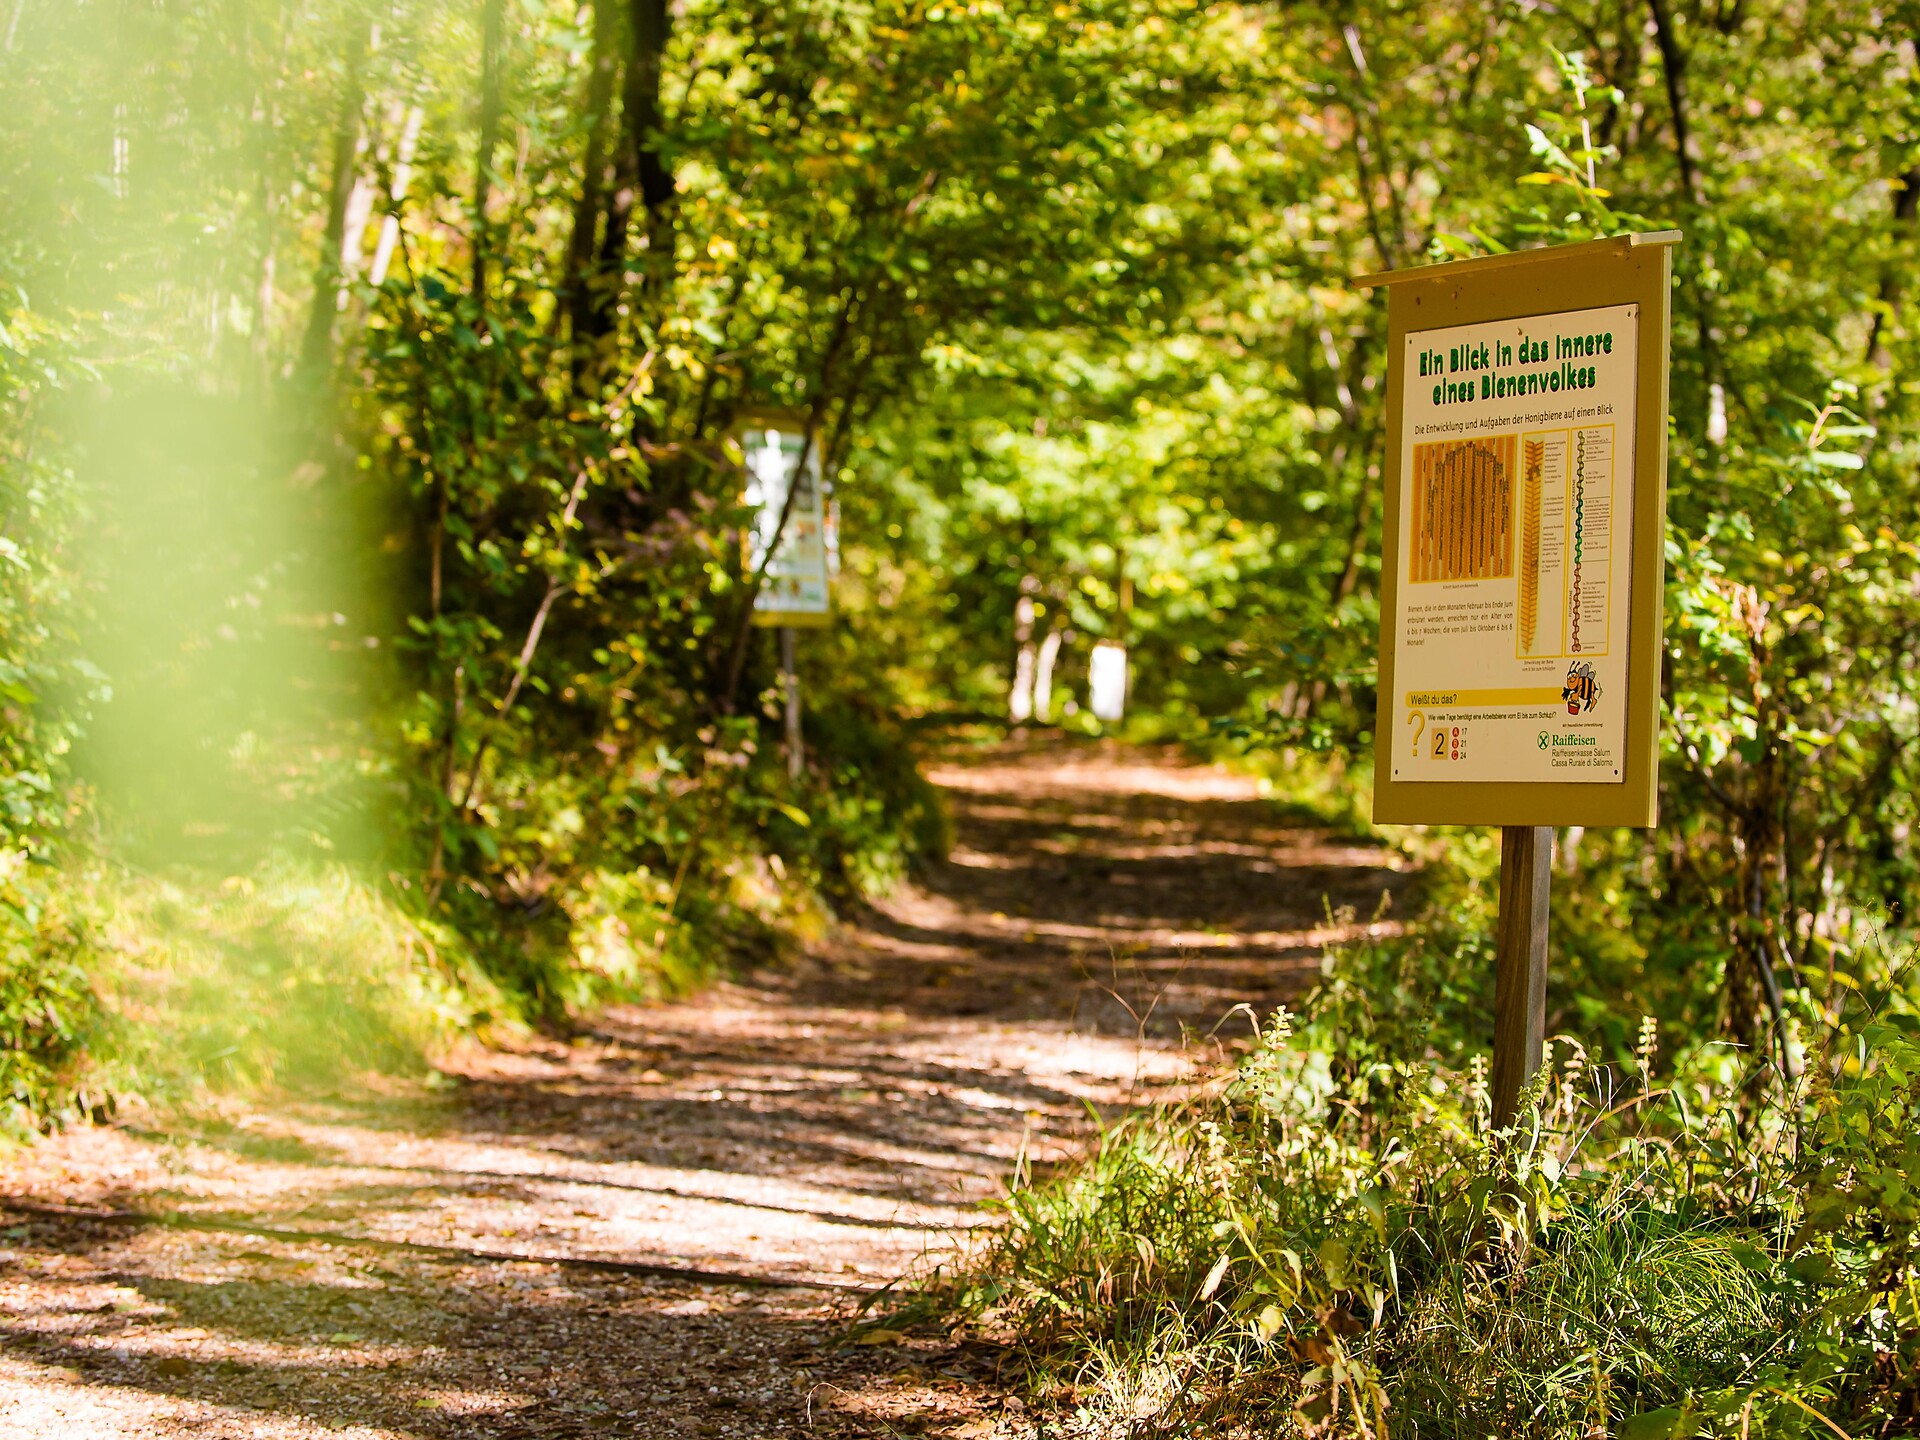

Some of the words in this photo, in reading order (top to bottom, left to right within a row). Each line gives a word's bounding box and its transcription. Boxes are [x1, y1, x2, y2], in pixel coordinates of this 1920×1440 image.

[1419, 348, 1443, 376] Ein
[1450, 342, 1489, 373] Blick
[1496, 339, 1512, 367] in
[1518, 335, 1549, 364] das
[1555, 332, 1612, 360] Innere
[1433, 377, 1475, 406] eines
[1481, 361, 1596, 400] Bienenvolkes
[1426, 420, 1463, 433] Entwicklung
[1465, 418, 1478, 429] und
[1480, 416, 1510, 430] Aufgaben
[1512, 414, 1524, 424] der
[1525, 411, 1562, 424] Honigbiene
[1564, 407, 1576, 421] auf
[1577, 407, 1596, 417] einen
[1597, 403, 1614, 415] Blick
[1447, 603, 1466, 611] Monaten
[1467, 602, 1484, 610] Februar
[1492, 600, 1503, 609] Ende
[1447, 614, 1468, 622] erreichen
[1491, 612, 1502, 620] Alter
[1477, 624, 1495, 632] Oktober
[1410, 694, 1430, 705] Weißt
[1441, 693, 1457, 704] das?
[1482, 712, 1507, 720] Arbeitsbiene
[1434, 732, 1445, 755] 2
[1552, 733, 1596, 746] Raiffeisen
[1551, 748, 1592, 757] Raiffeisenkasse
[1593, 748, 1611, 757] Salurn
[1551, 758, 1568, 767] Cassa
[1569, 758, 1586, 767] Rurale
[1592, 757, 1614, 767] Salorno
